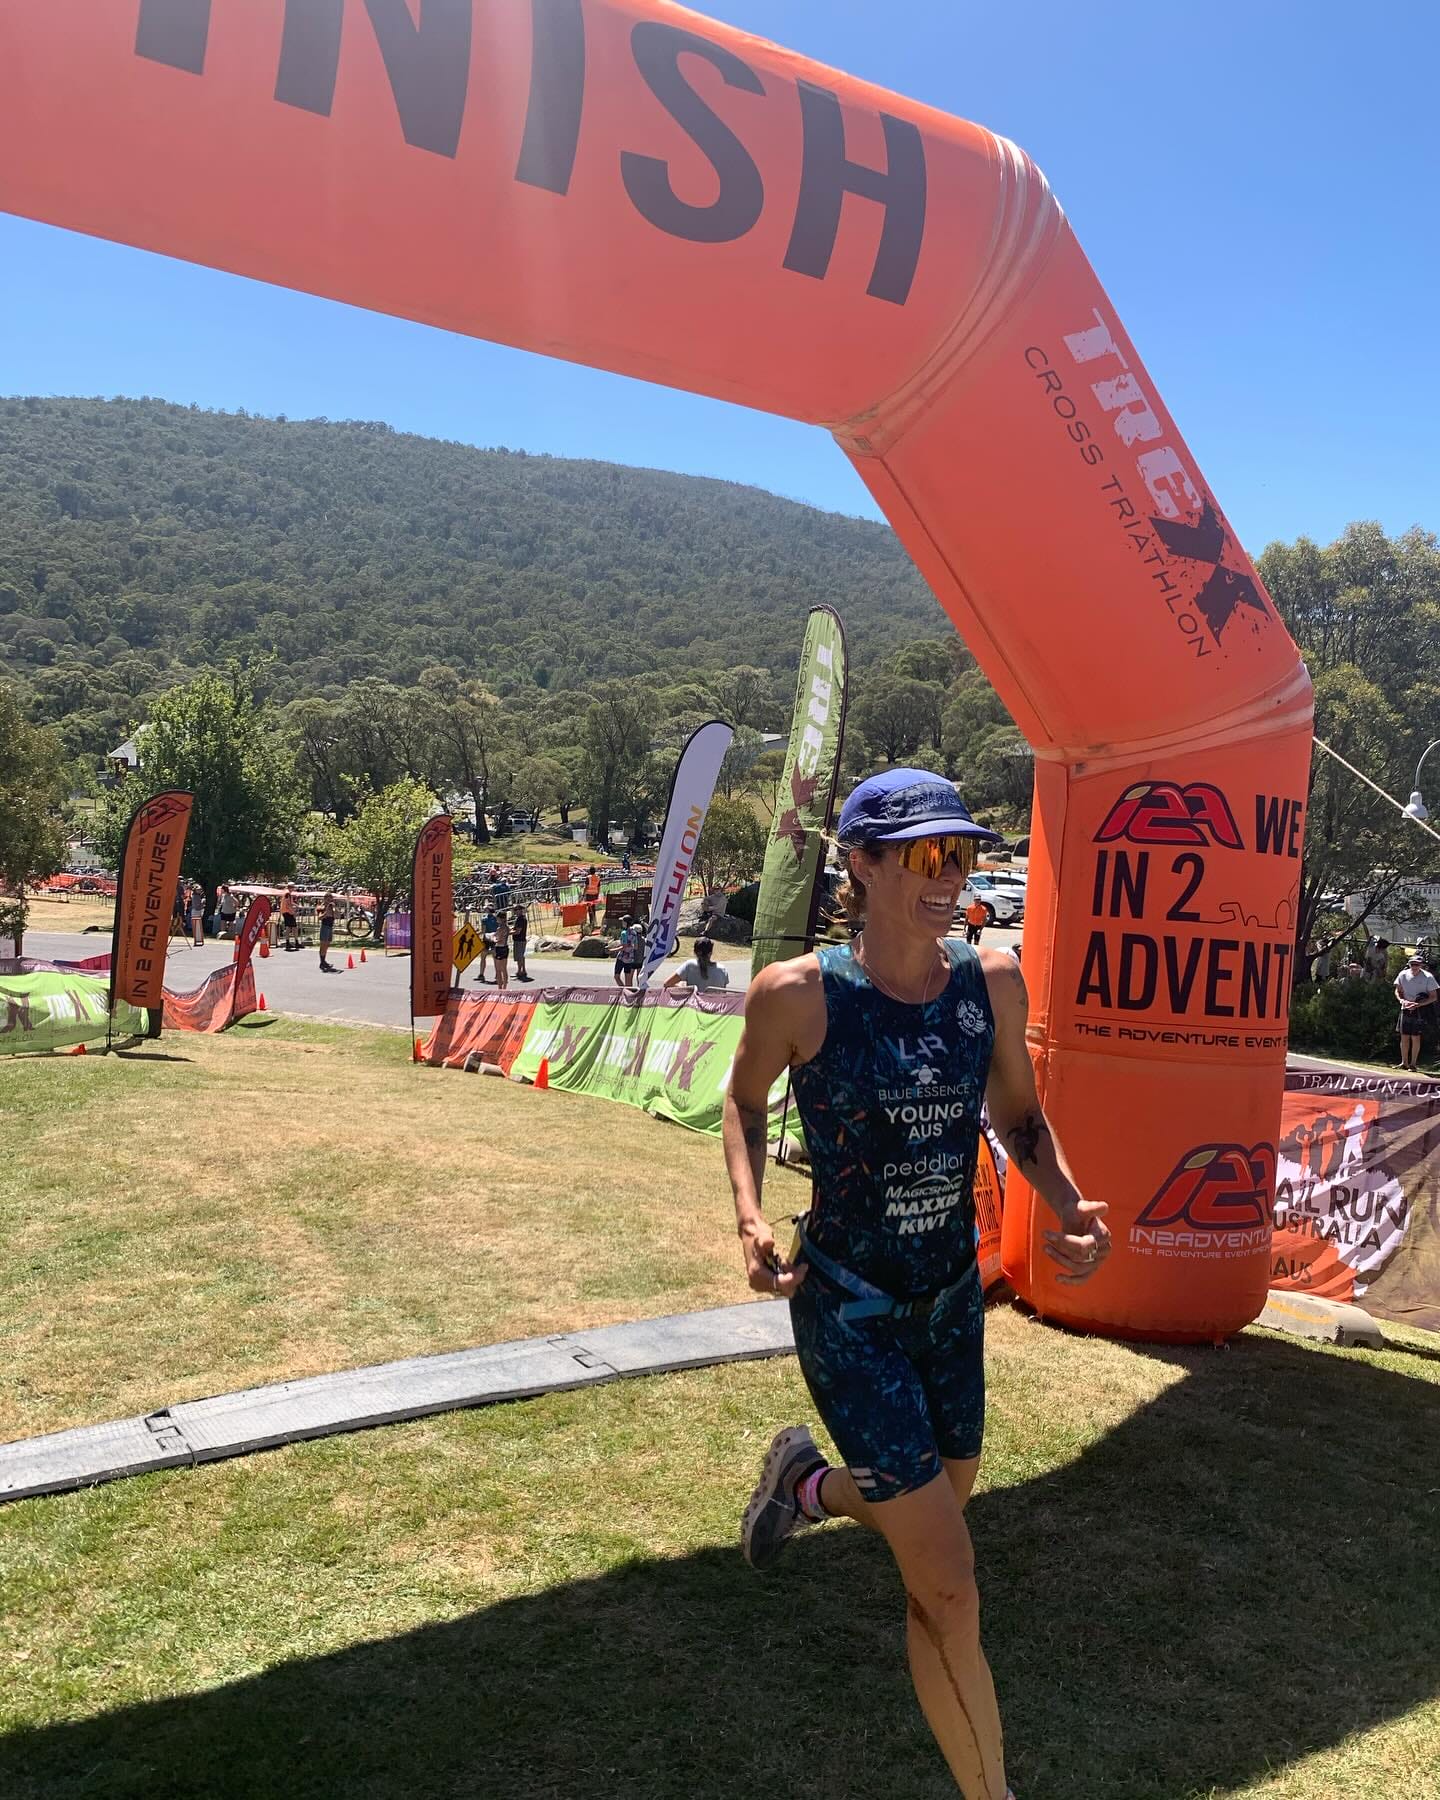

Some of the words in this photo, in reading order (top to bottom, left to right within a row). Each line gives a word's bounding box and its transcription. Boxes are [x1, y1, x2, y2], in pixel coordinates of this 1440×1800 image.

[1063, 307, 1273, 647] TREX
[1024, 346, 1104, 466] CROSS
[1101, 474, 1210, 659] TRIATHLON
[1255, 794, 1302, 858] WE
[139, 831, 172, 951] ADVENTURE
[1092, 850, 1149, 919] IN
[1166, 852, 1204, 921] 2
[432, 853, 444, 963] ADVENTURE
[136, 958, 152, 972] 2
[433, 971, 444, 983] 2
[1075, 931, 1293, 1019] ADVENT
[131, 979, 149, 998] IN
[435, 989, 446, 1008] IN
[1075, 1023, 1111, 1038] THE
[1118, 1027, 1239, 1047] ADVENTURE
[1245, 1035, 1281, 1048] EVENT
[878, 1087, 912, 1100] BLUE
[916, 1083, 970, 1098] ESSENCE
[884, 1102, 964, 1124] YOUNG
[908, 1122, 943, 1140] AUS
[883, 1153, 965, 1180] peddlar
[885, 1191, 961, 1216] MAXXIS
[1329, 1184, 1408, 1231] RUN
[898, 1211, 950, 1235] KWT
[1128, 1246, 1153, 1255] THE
[1157, 1249, 1222, 1259] ADVENTURE
